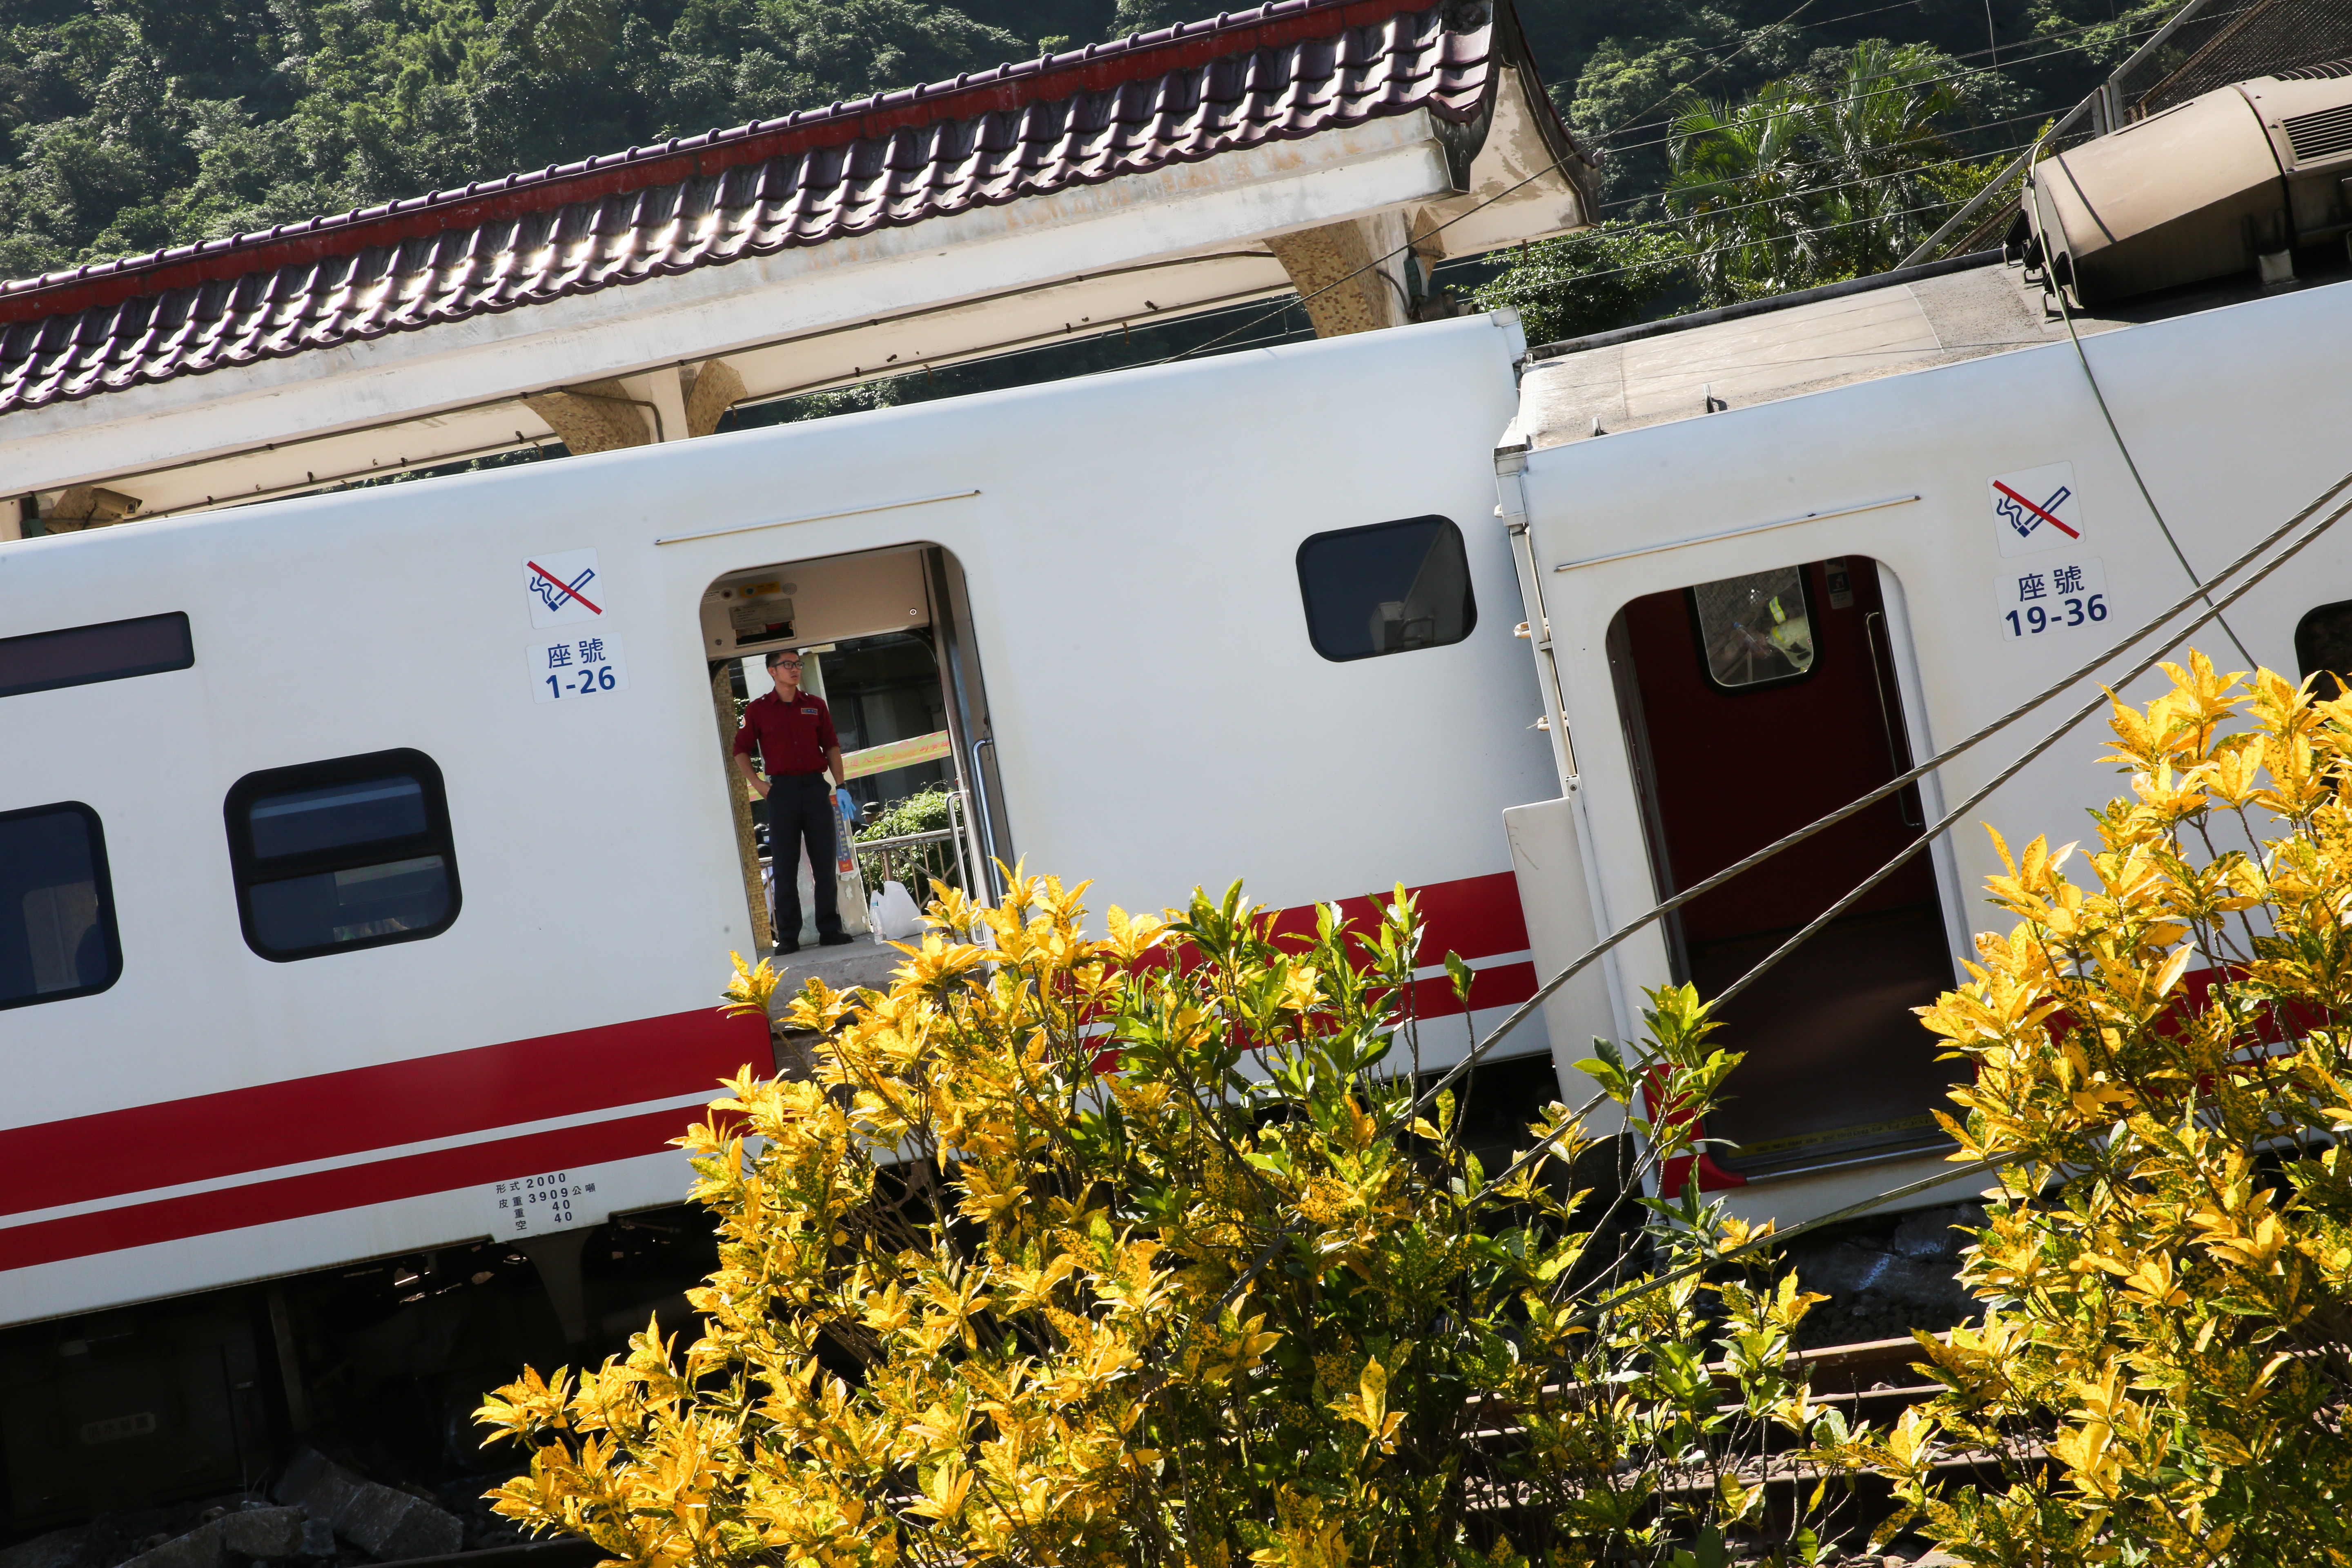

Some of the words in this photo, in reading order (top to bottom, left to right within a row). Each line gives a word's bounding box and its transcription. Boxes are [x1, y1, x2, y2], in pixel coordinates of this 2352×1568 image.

[2018, 566, 2085, 602] 座號
[2005, 594, 2107, 637] 19-36
[548, 638, 606, 669] 座號
[546, 666, 616, 699] 1-26
[496, 1181, 520, 1194] 形式
[526, 1173, 566, 1188] 2000
[499, 1196, 523, 1209] 皮重
[572, 1183, 596, 1195] 公噸
[514, 1208, 525, 1218] 重
[552, 1200, 570, 1211] 40
[515, 1220, 527, 1231] 空
[555, 1212, 572, 1223] 40
